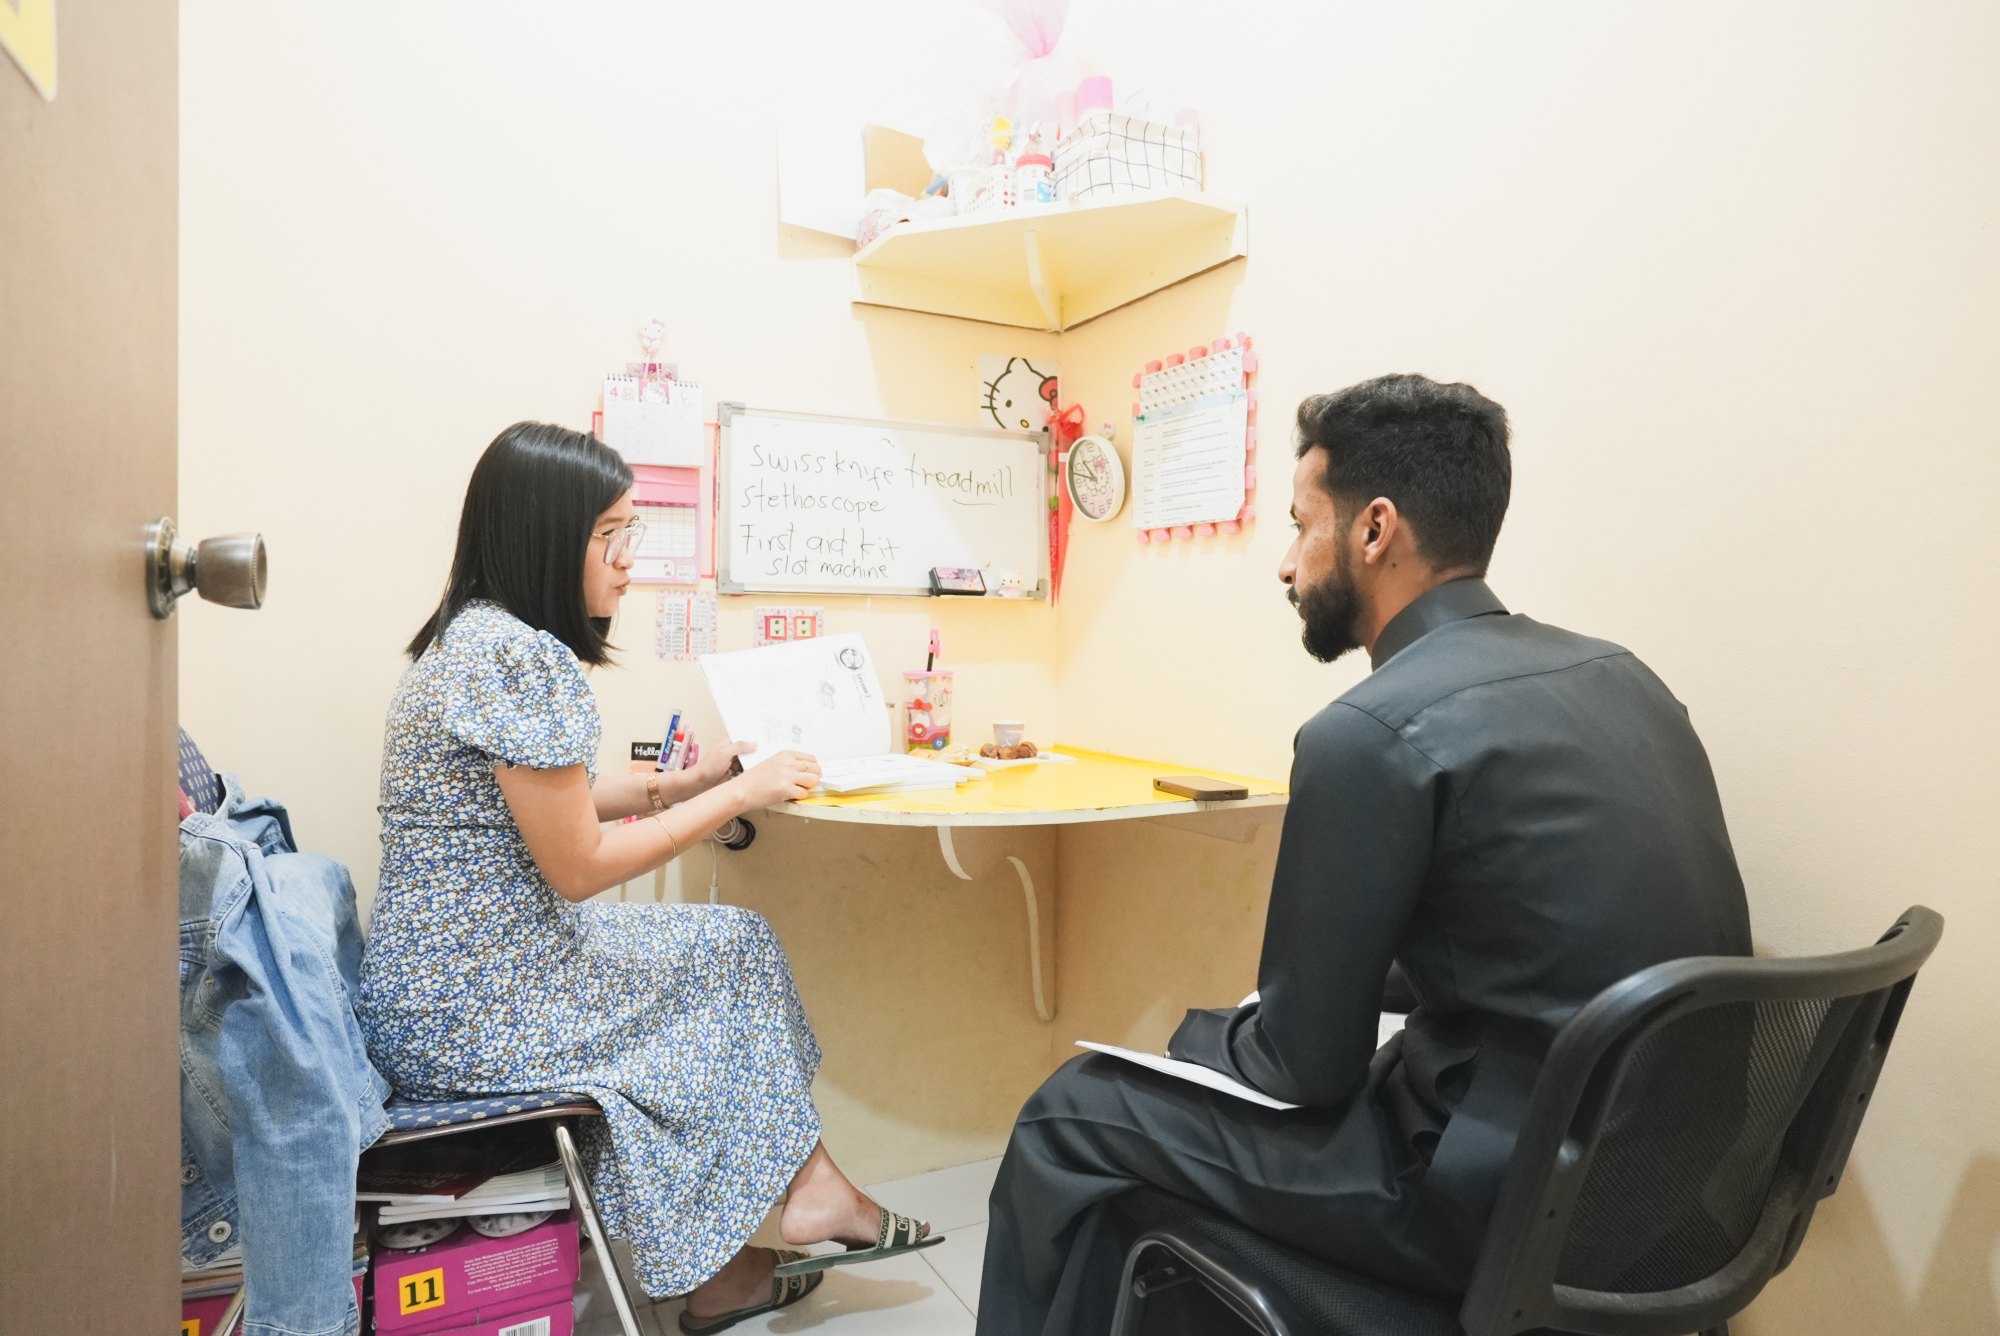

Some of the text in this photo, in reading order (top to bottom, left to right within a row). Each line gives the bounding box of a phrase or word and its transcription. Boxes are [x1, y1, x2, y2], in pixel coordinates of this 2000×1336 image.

[750, 444, 1014, 498] Swiss knife treadmill
[739, 522, 901, 561] First aid kit
[820, 558, 889, 581] machine
[634, 744, 661, 757] Hello
[404, 1276, 440, 1308] 11
